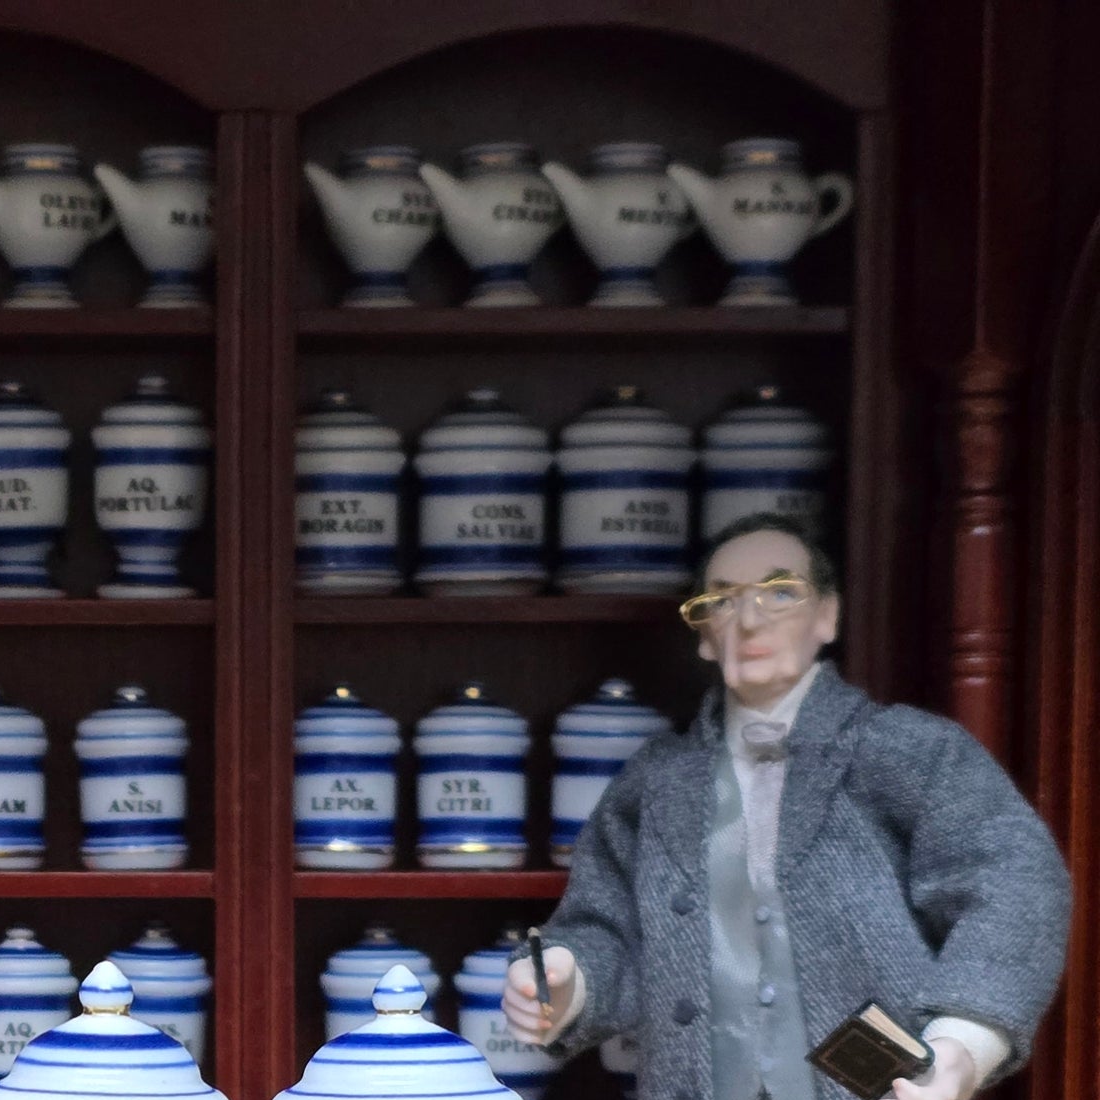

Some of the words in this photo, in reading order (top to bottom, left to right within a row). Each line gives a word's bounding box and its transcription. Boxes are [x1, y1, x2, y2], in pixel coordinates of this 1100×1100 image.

[127, 781, 144, 796] S.
[330, 778, 364, 793] AX.
[441, 778, 487, 794] SYR.
[108, 799, 164, 815] ANISI
[436, 796, 493, 813] CITRI
[4, 1021, 37, 1039] AQ.
